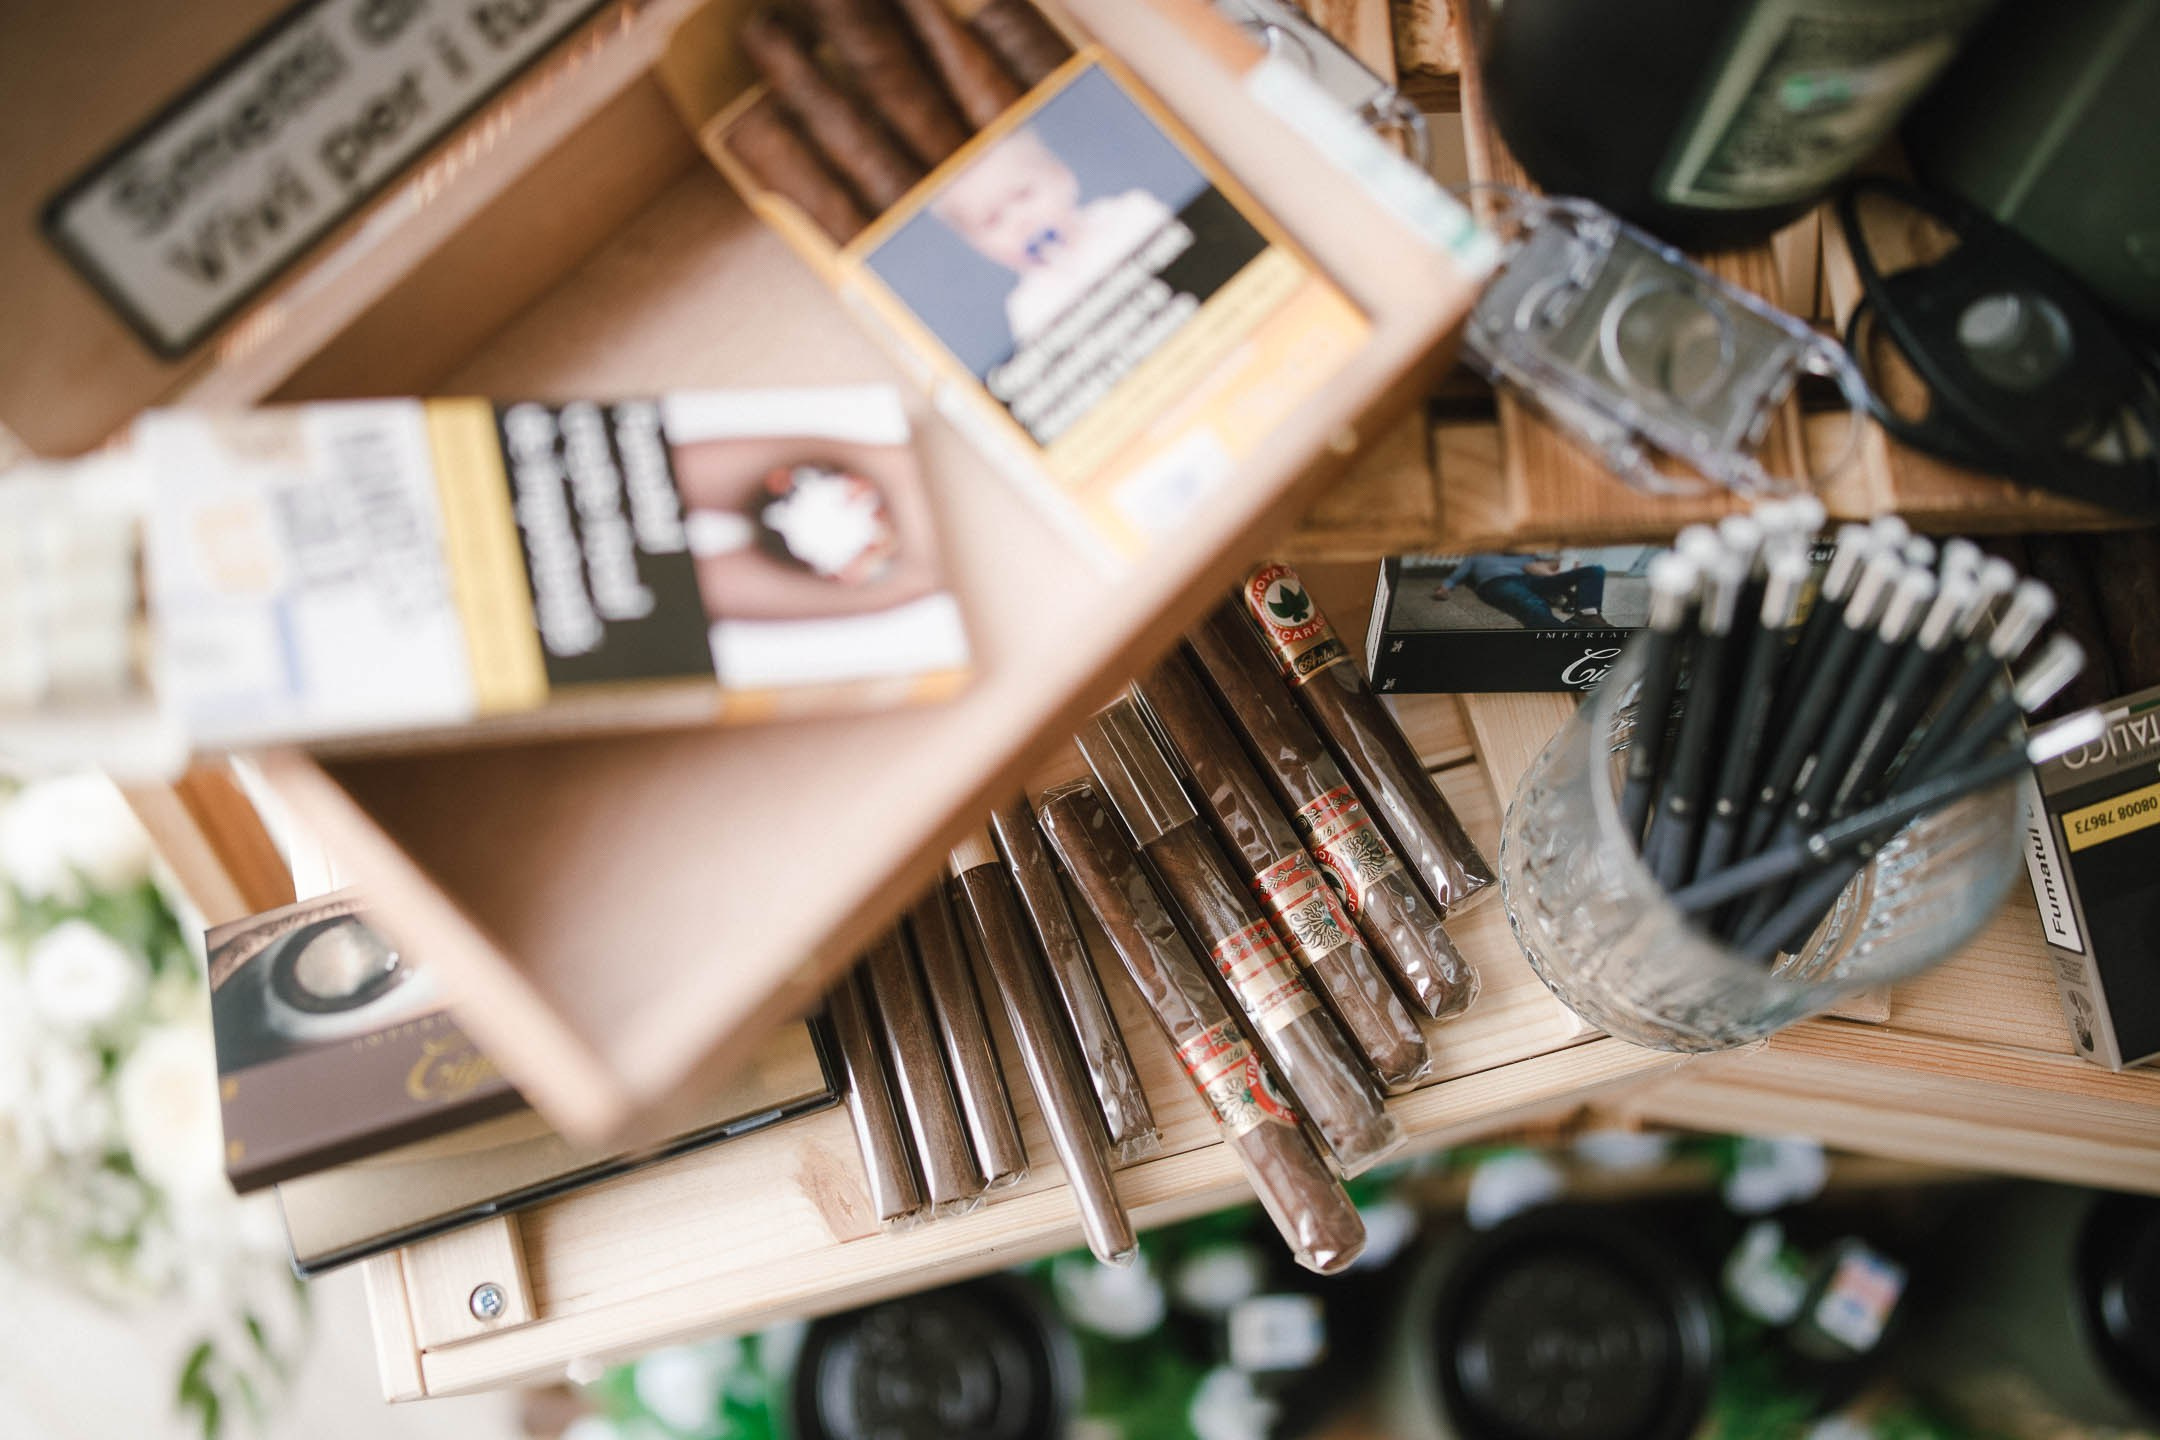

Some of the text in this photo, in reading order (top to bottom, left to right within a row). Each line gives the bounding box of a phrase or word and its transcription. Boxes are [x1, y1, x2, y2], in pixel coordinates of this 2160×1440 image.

[166, 160, 315, 287] Vivi
[320, 68, 428, 188] per
[430, 27, 472, 81] i
[1536, 631, 1630, 640] IMPERIAL
[2074, 796, 2158, 835] 08008 78673
[2027, 826, 2067, 936] Fumatul
